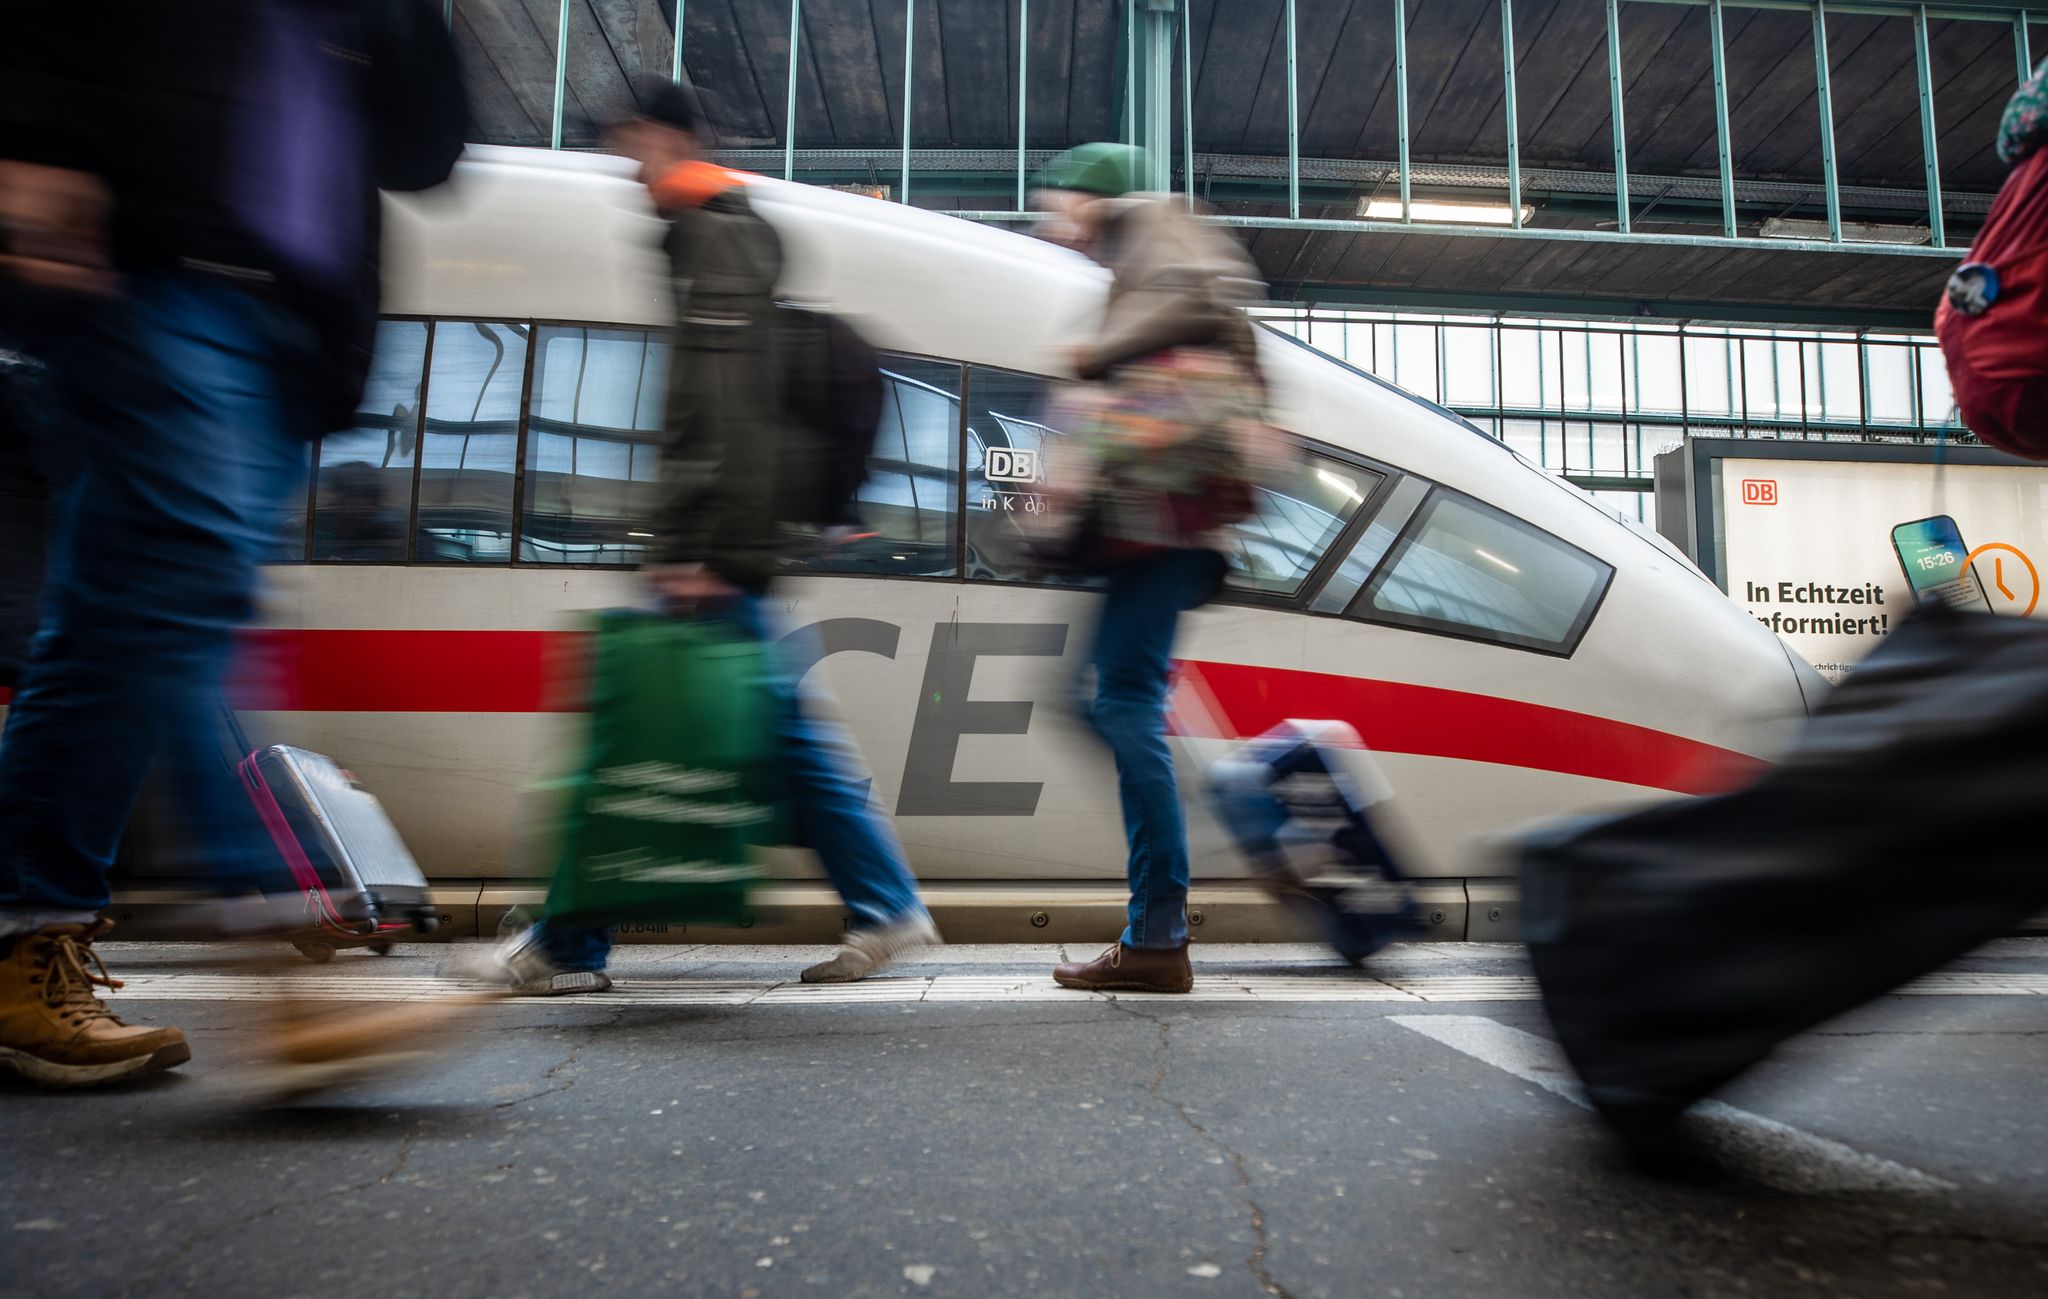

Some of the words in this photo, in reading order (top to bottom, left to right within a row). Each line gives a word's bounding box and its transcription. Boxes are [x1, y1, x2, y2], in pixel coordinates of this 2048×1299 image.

[990, 452, 1031, 477] DB
[982, 495, 997, 510] in
[1746, 483, 1774, 501] DB
[1916, 551, 1955, 570] 15:26
[1746, 581, 1770, 603] In
[1778, 582, 1885, 605] Echtzeit
[1748, 611, 1888, 636] nformiert!
